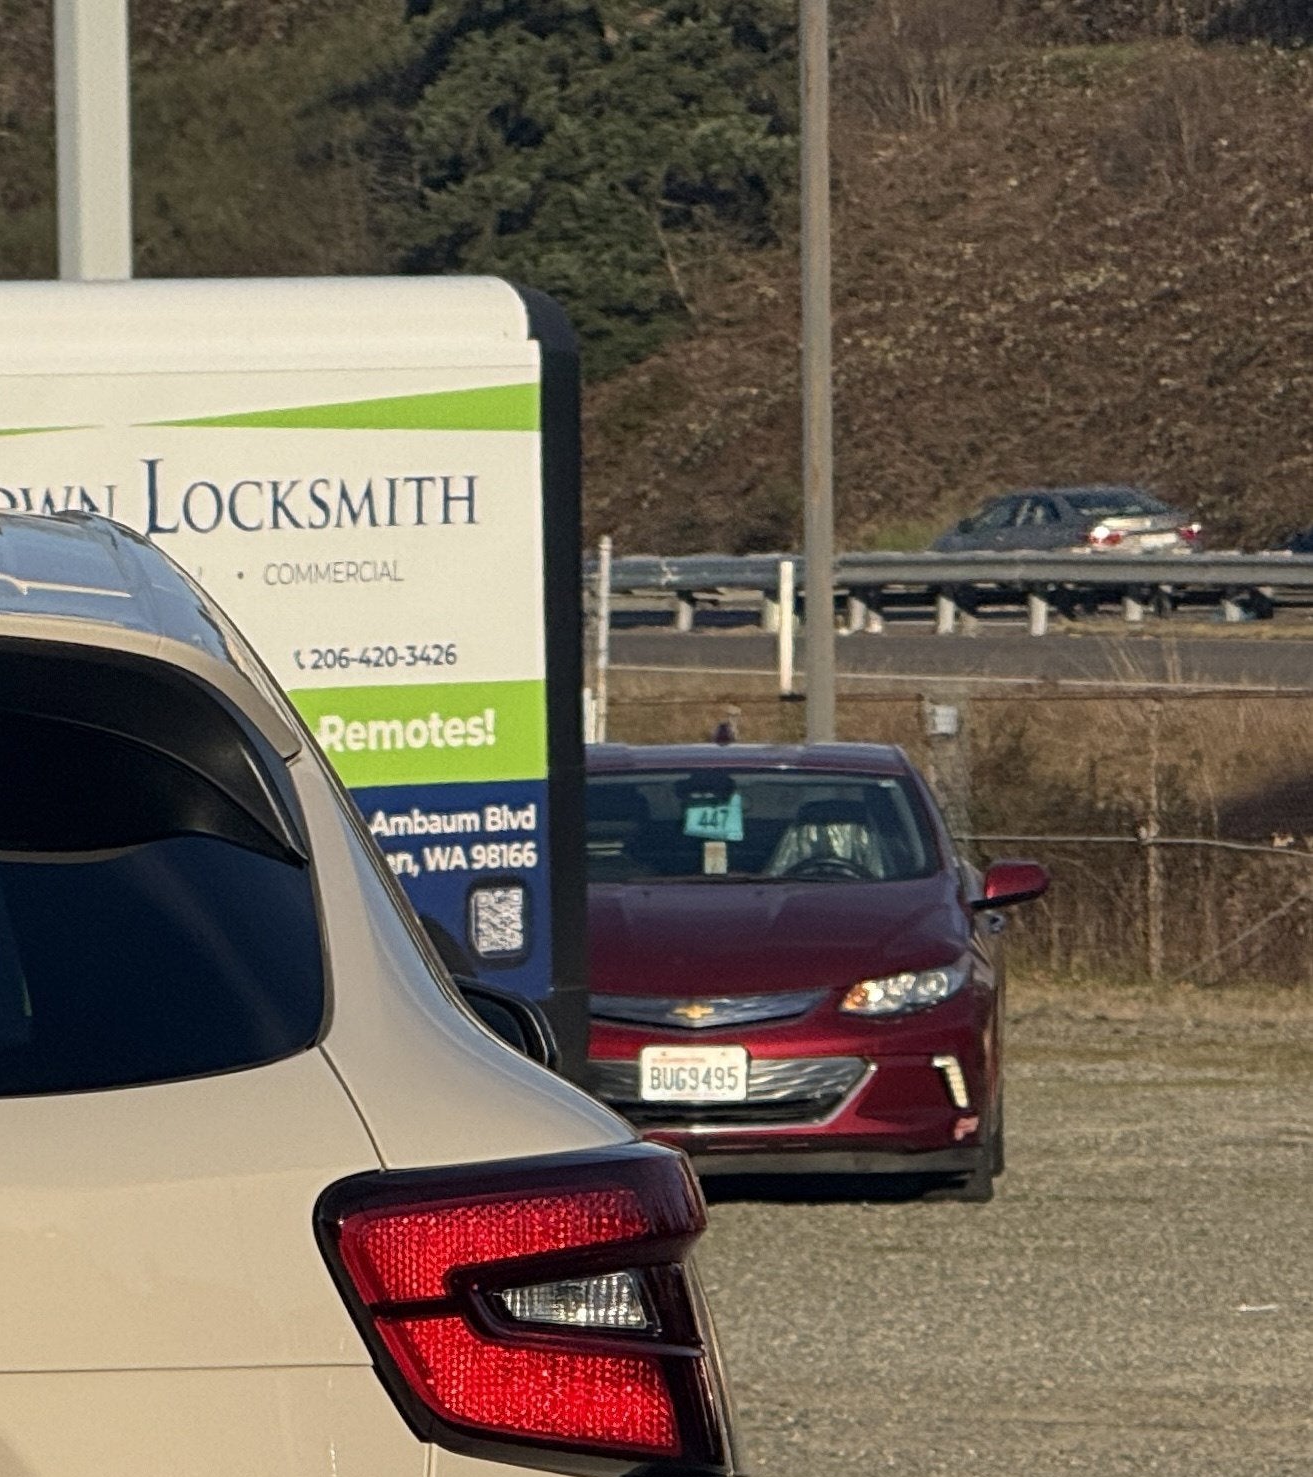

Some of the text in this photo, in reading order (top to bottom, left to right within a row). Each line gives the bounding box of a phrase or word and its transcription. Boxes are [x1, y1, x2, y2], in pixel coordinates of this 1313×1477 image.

[141, 458, 479, 536] LOCKSMITH
[263, 560, 404, 586] COMMERCIAL
[310, 644, 458, 670] 206-420-3426
[318, 708, 496, 751] Remotes!
[370, 804, 537, 837] Ambaum Blvd
[423, 846, 468, 872] WA
[471, 842, 537, 870] 98166
